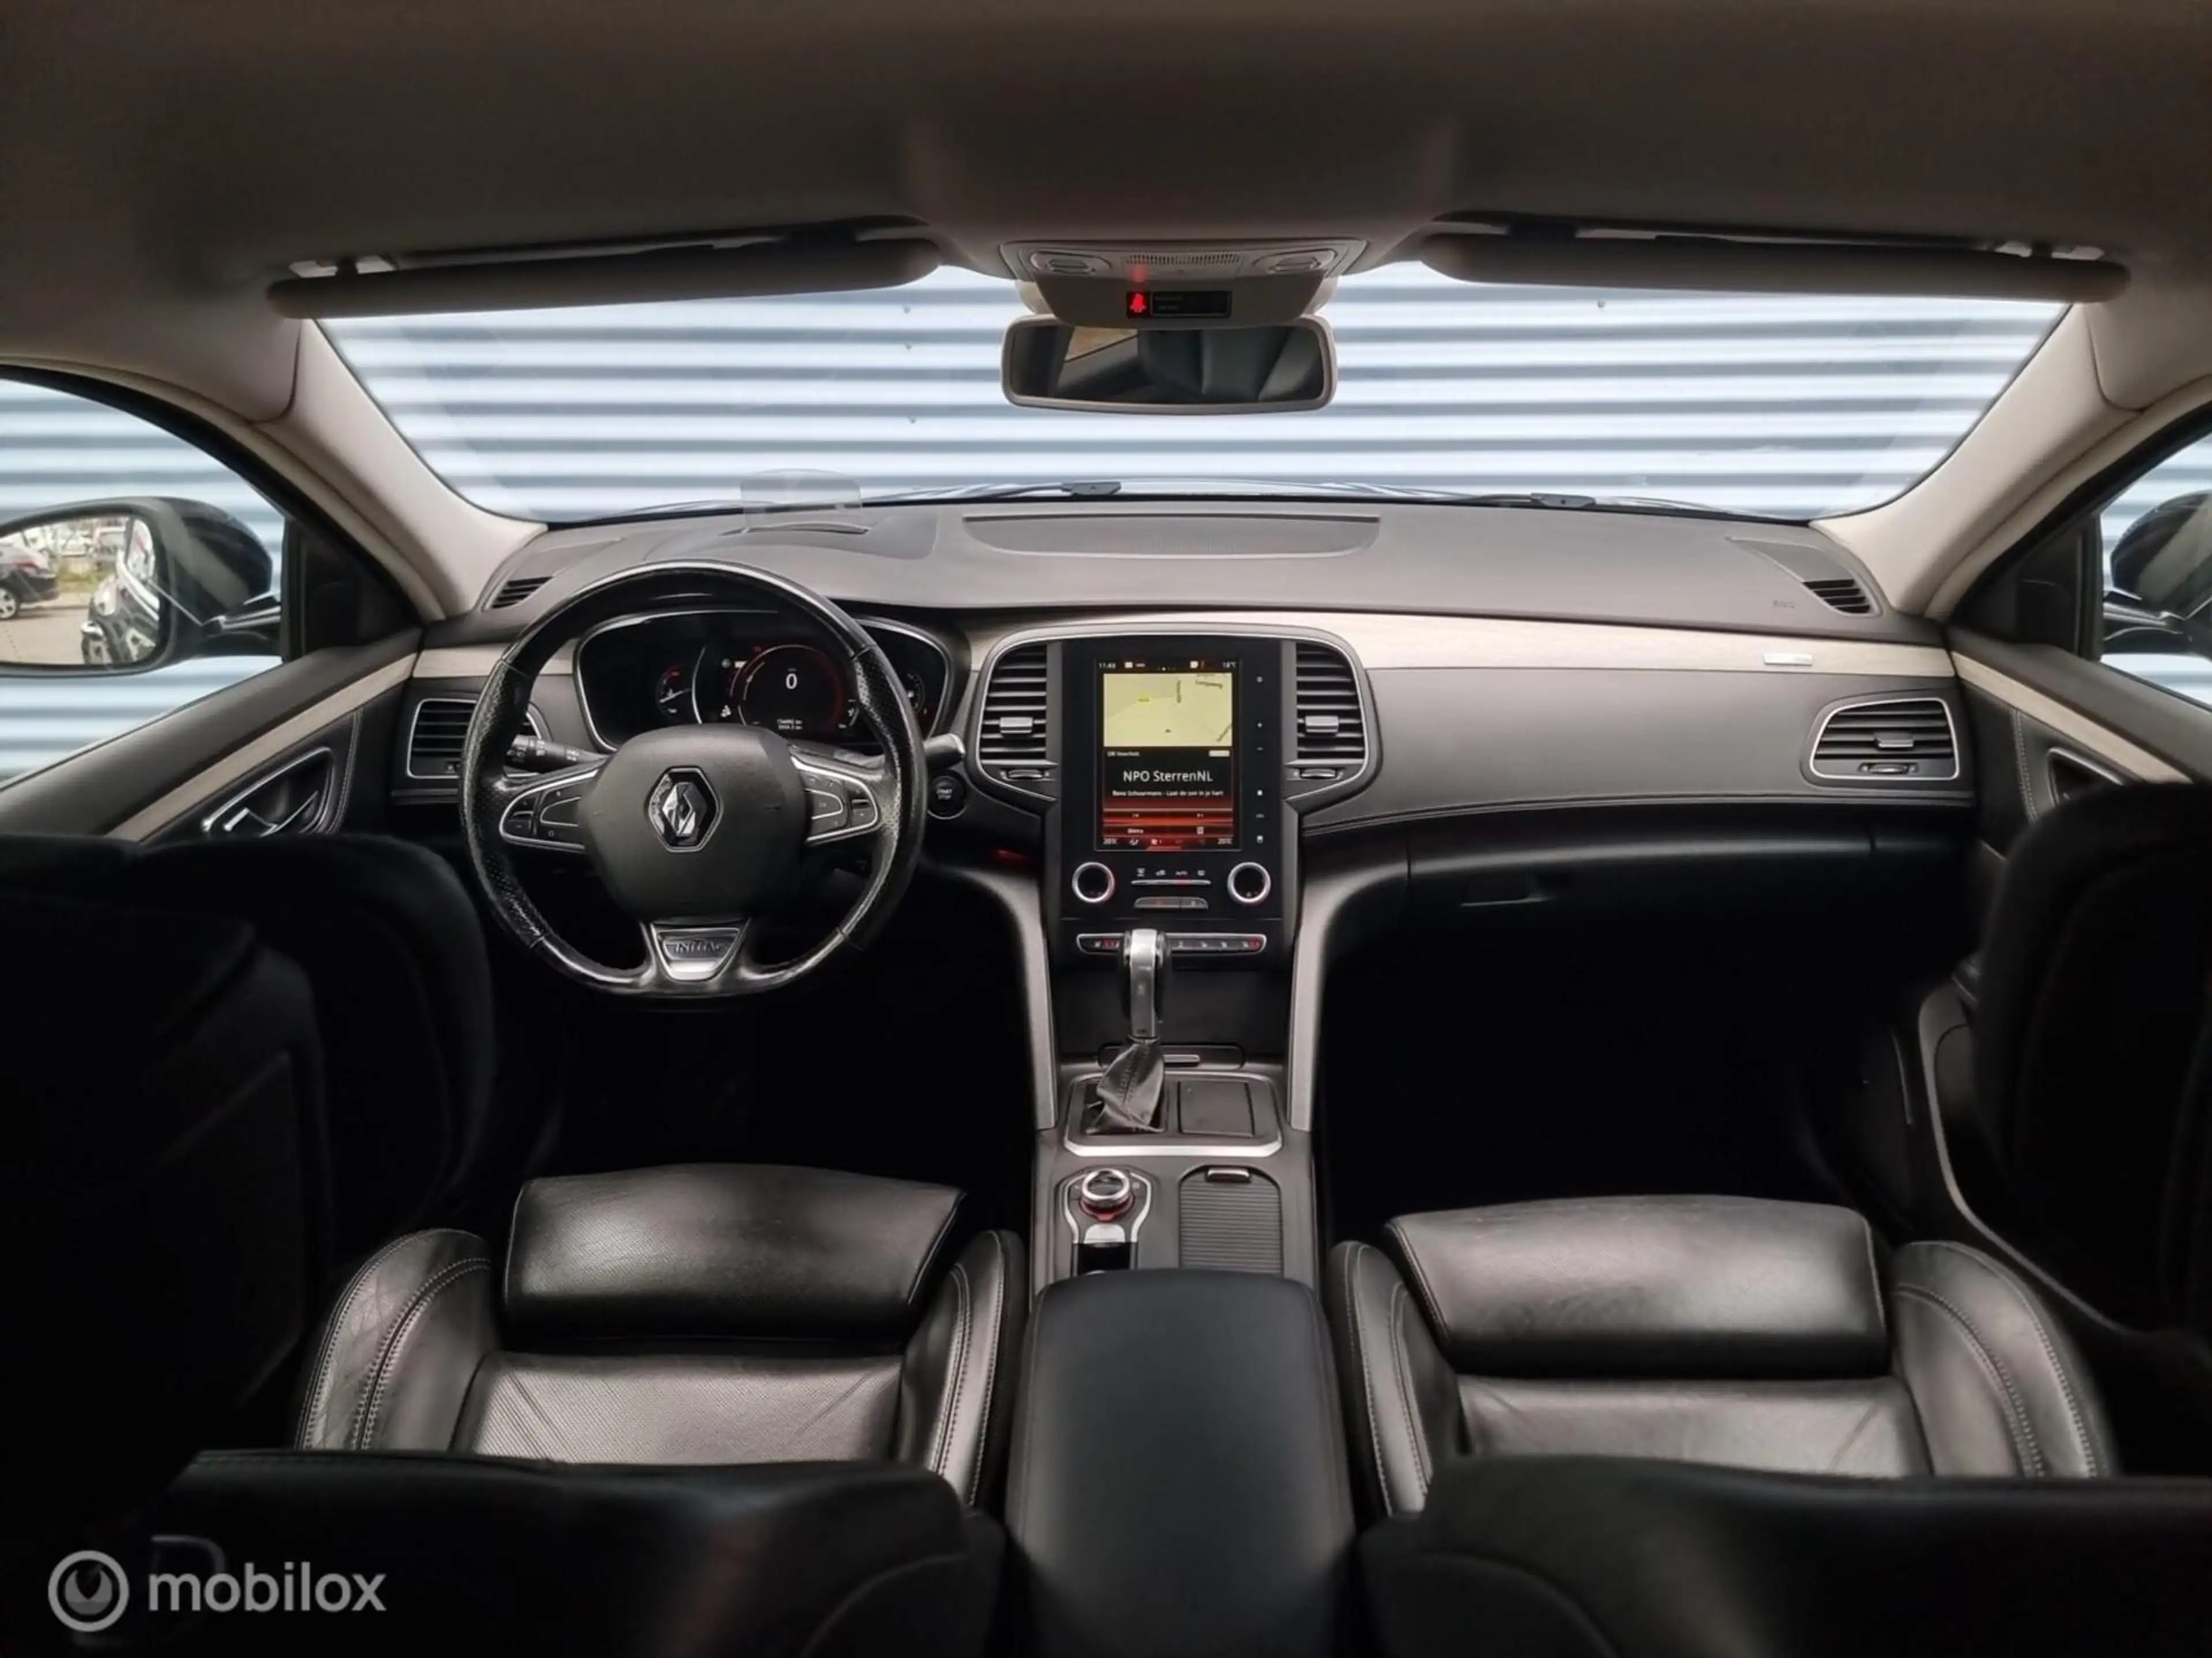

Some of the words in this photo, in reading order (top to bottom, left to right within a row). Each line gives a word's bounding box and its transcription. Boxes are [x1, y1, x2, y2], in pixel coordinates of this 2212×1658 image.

[786, 673, 798, 690] 0
[1123, 770, 1150, 783] NPO
[1153, 770, 1214, 783] SterrenNL
